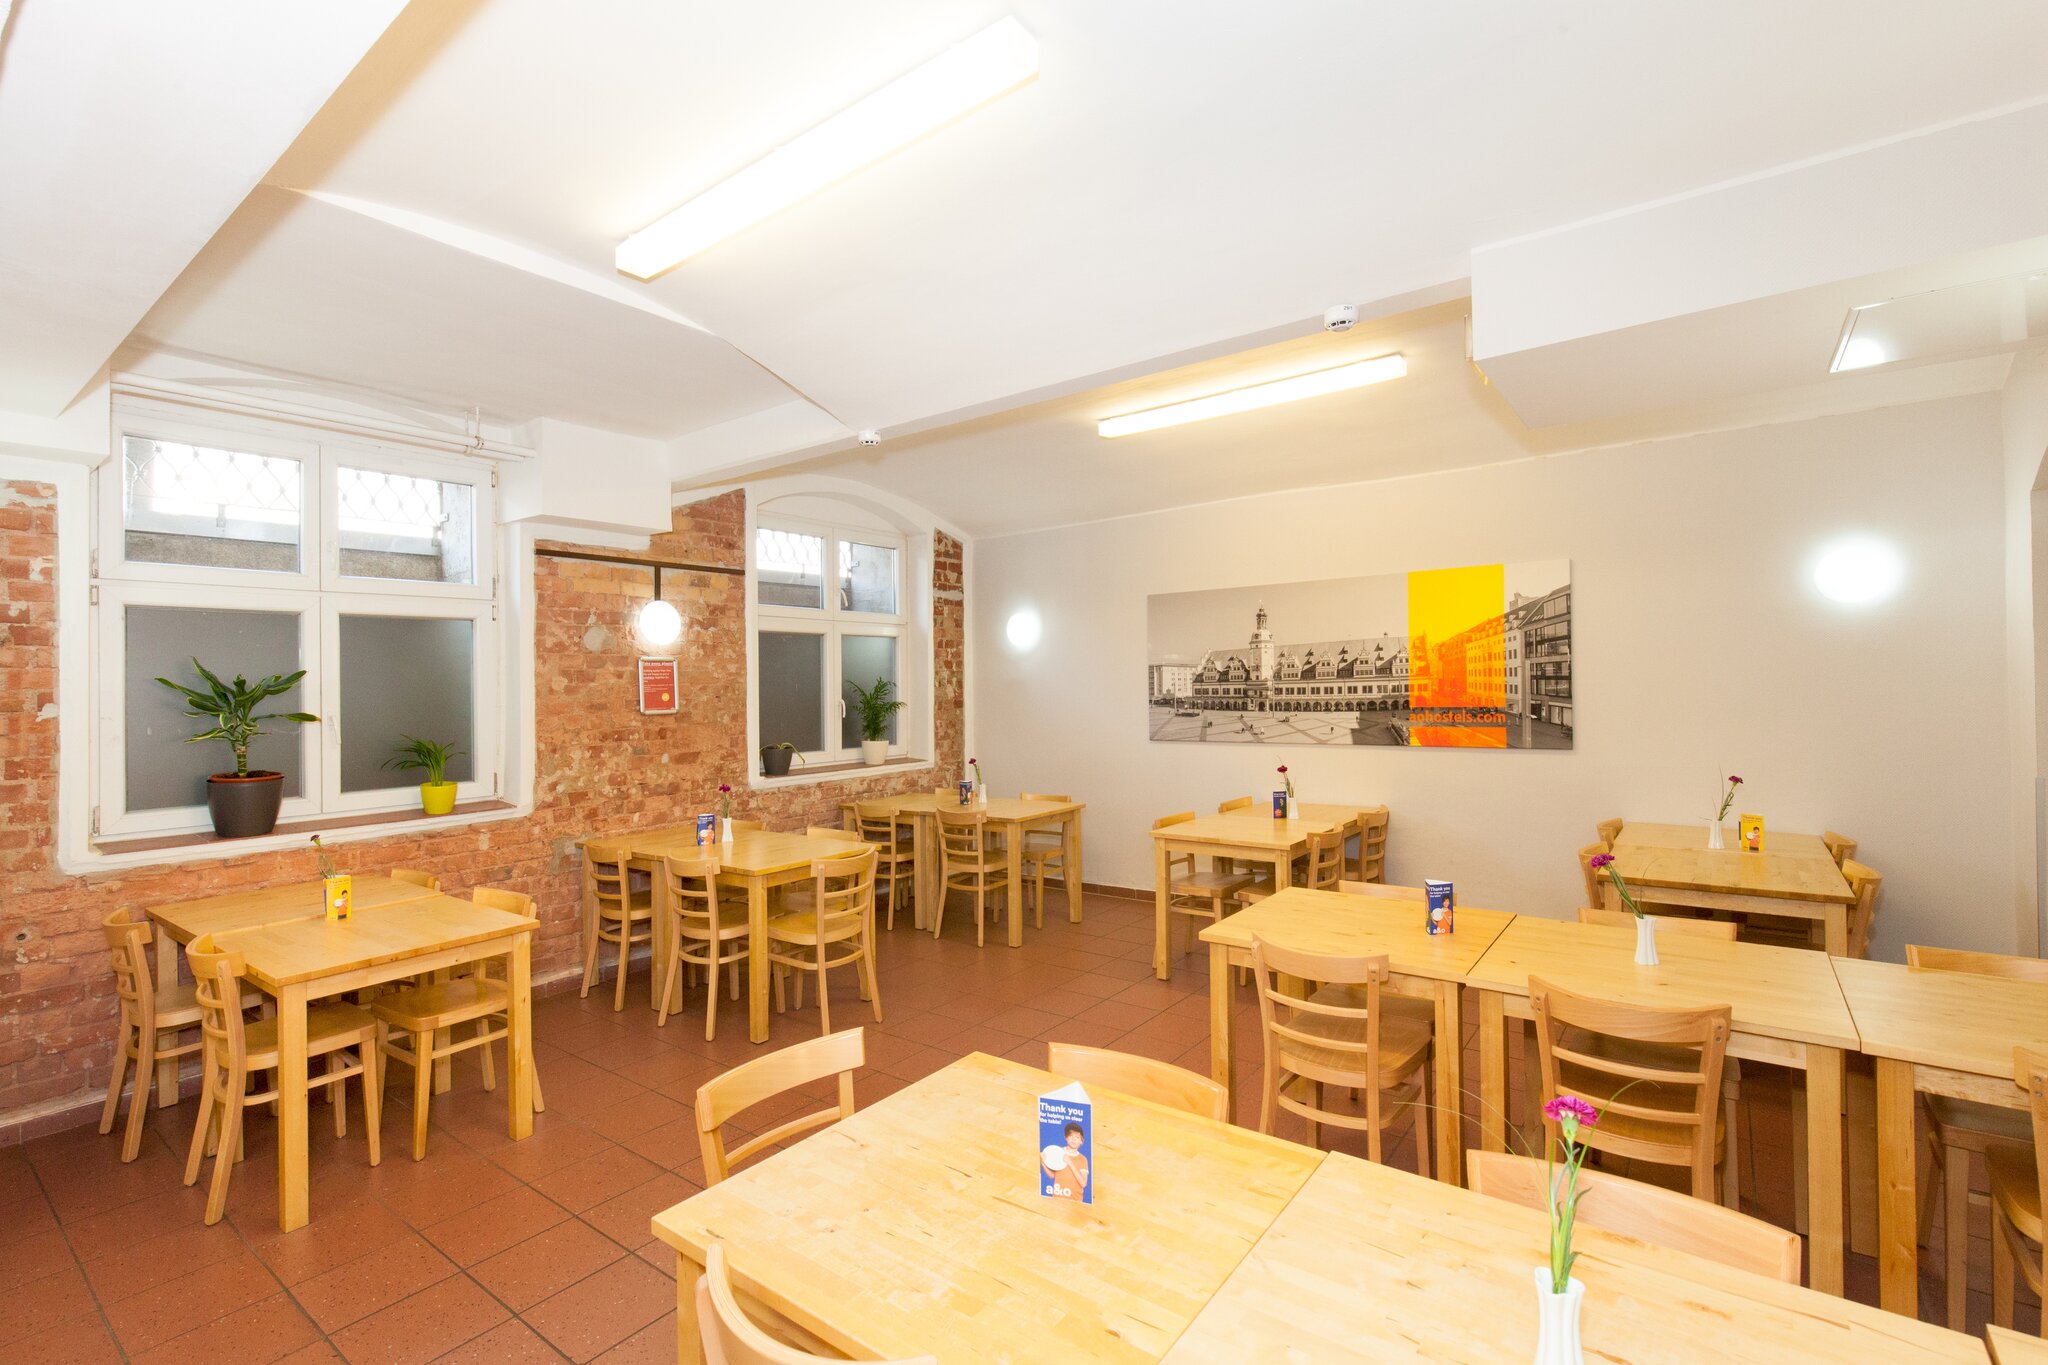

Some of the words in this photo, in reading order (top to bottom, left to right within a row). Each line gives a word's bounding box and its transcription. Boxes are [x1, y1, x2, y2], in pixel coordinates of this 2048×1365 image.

[1409, 709, 1506, 723] aohostels.com
[1040, 1102, 1066, 1113] Thank
[1067, 1107, 1083, 1116] you
[1045, 1183, 1072, 1197] a&o
